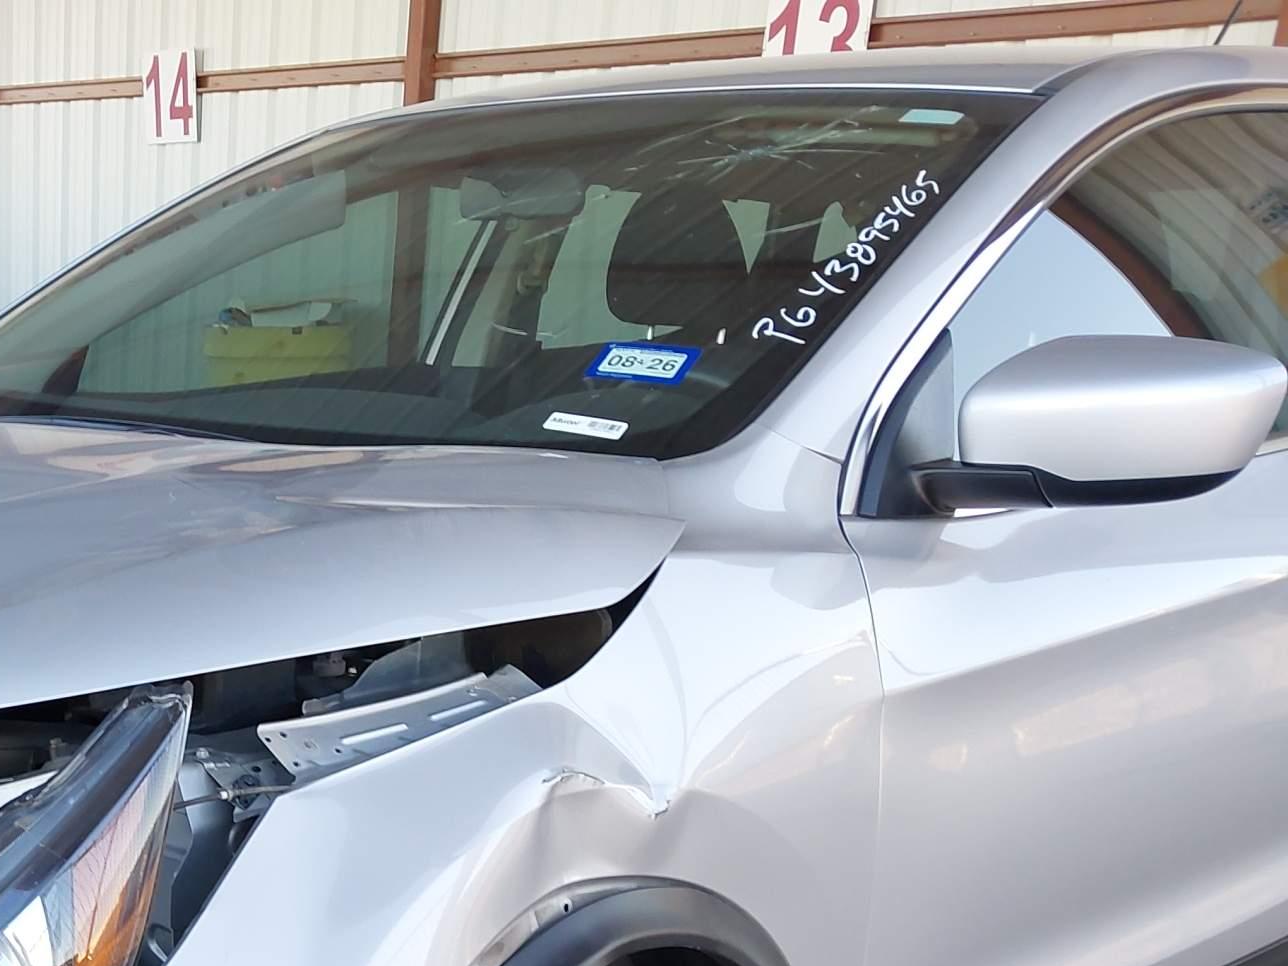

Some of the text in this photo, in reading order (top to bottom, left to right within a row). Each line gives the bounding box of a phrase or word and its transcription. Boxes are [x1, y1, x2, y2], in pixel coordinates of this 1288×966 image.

[146, 52, 193, 137] 14
[607, 354, 680, 373] 08 26
